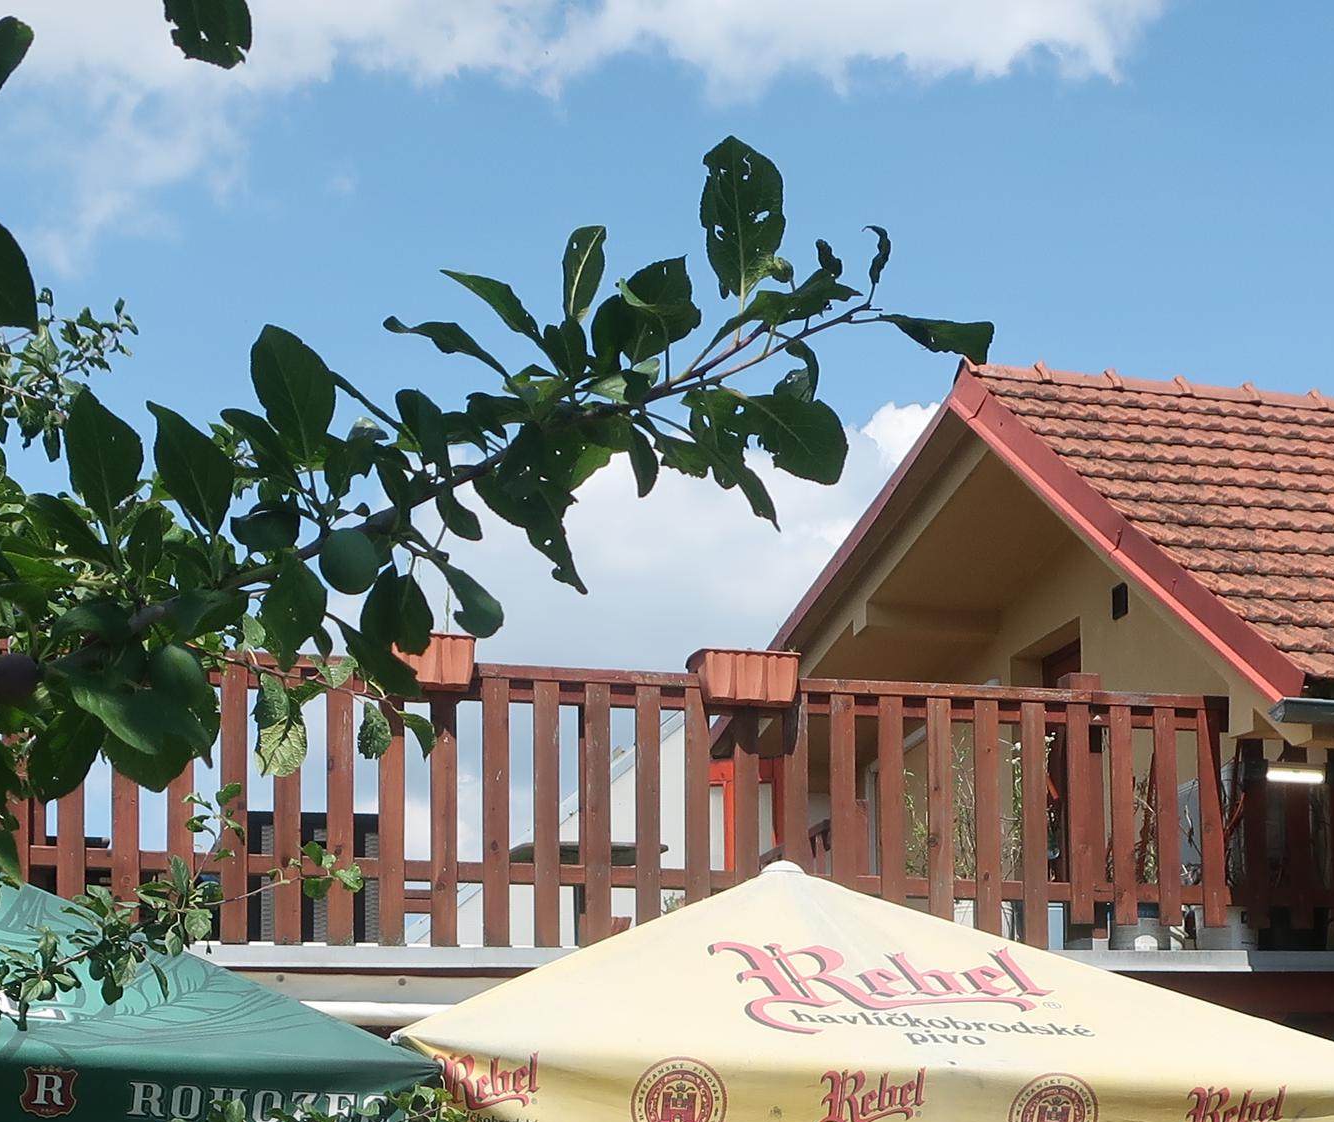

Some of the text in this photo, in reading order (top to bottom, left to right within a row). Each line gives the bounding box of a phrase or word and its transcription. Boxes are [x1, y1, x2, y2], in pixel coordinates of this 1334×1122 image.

[707, 941, 1055, 1034] Rebel
[788, 1009, 1096, 1039] havlíčkobrodské
[904, 1030, 986, 1046] pivo
[32, 1074, 65, 1106] R
[433, 1050, 540, 1111] Rebel
